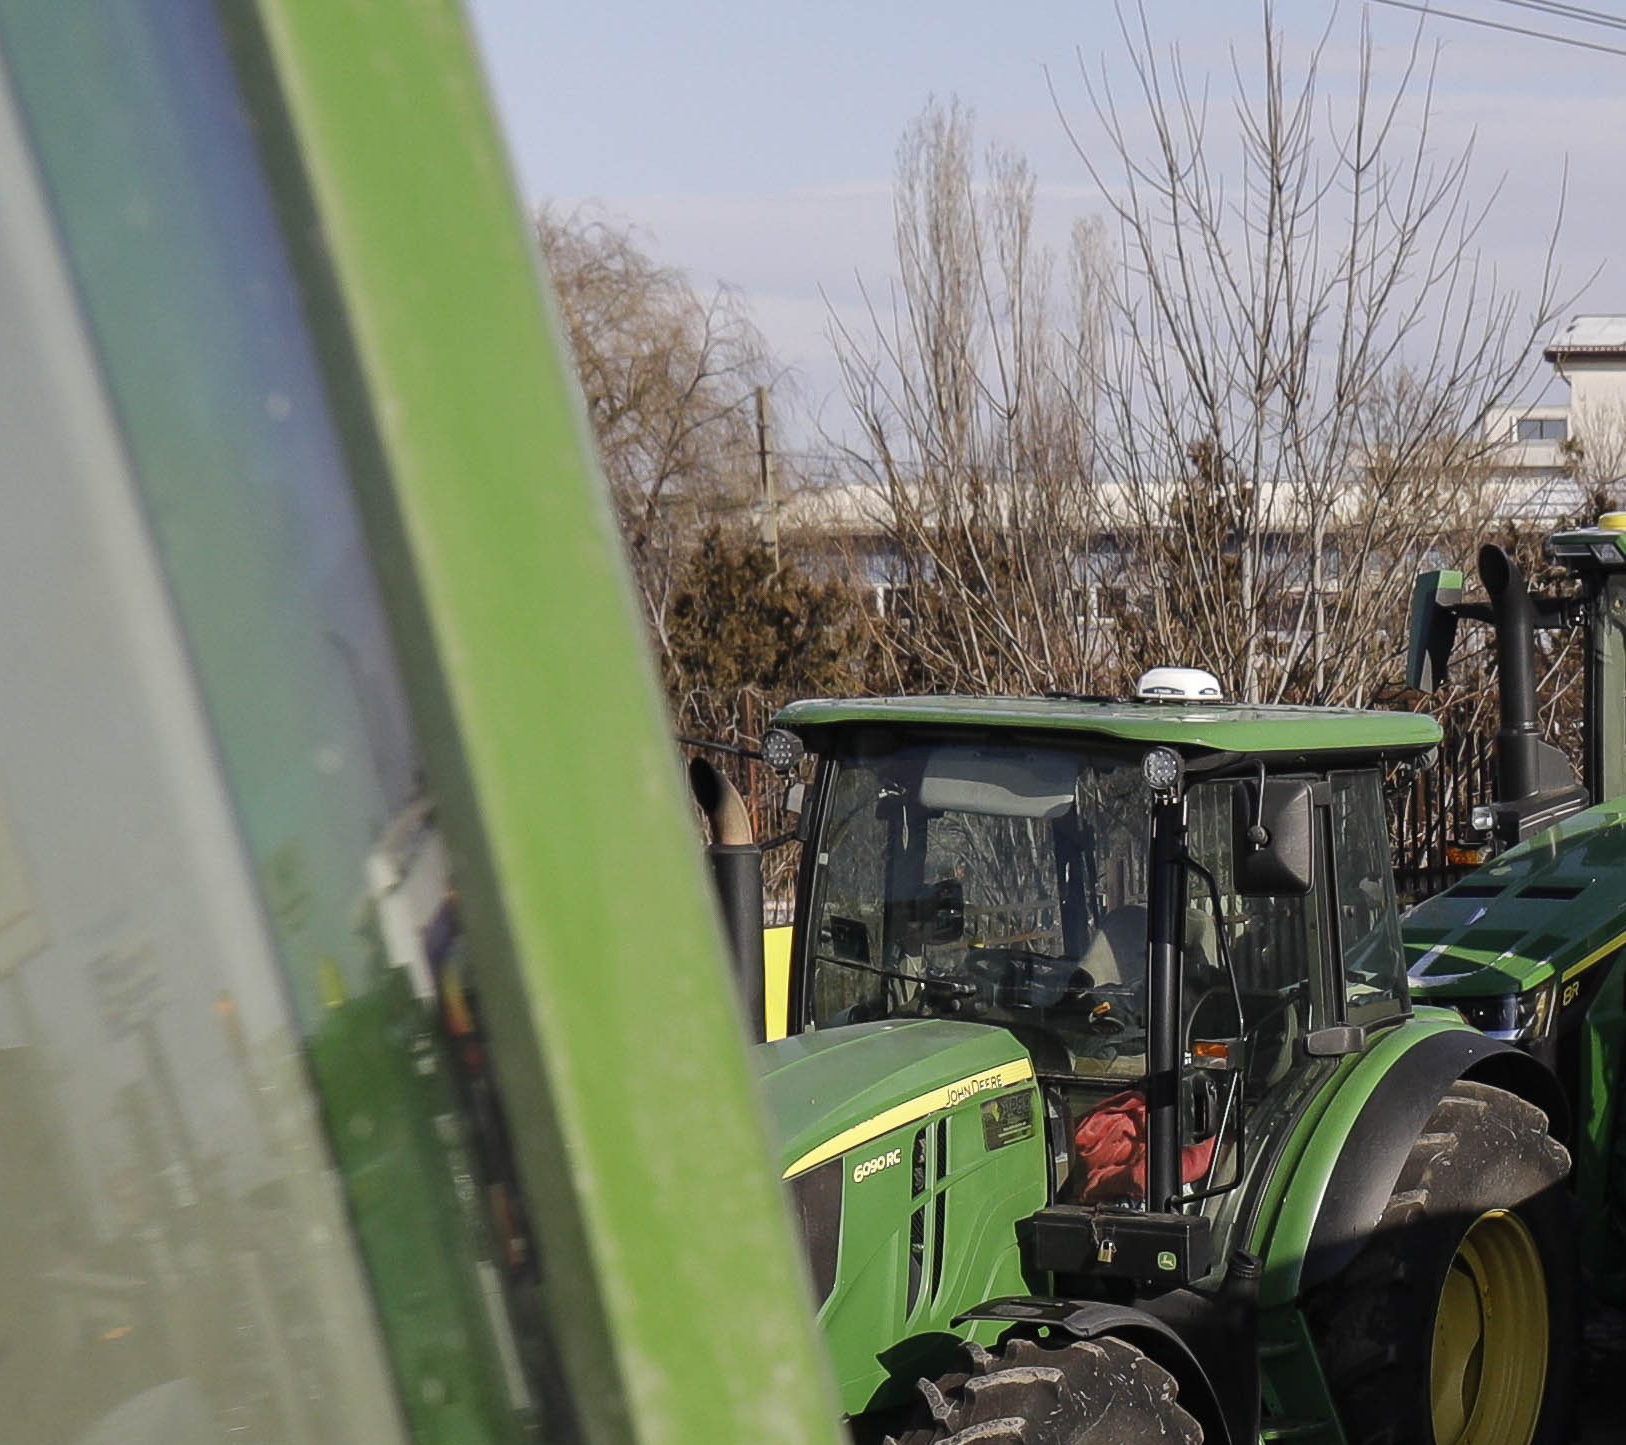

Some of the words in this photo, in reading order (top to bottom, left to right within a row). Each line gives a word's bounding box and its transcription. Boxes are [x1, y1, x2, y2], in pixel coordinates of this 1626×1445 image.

[945, 1086, 971, 1108] JOHN
[971, 1074, 1003, 1096] DEERE
[853, 1157, 886, 1184] 6090
[885, 1148, 902, 1169] RC
